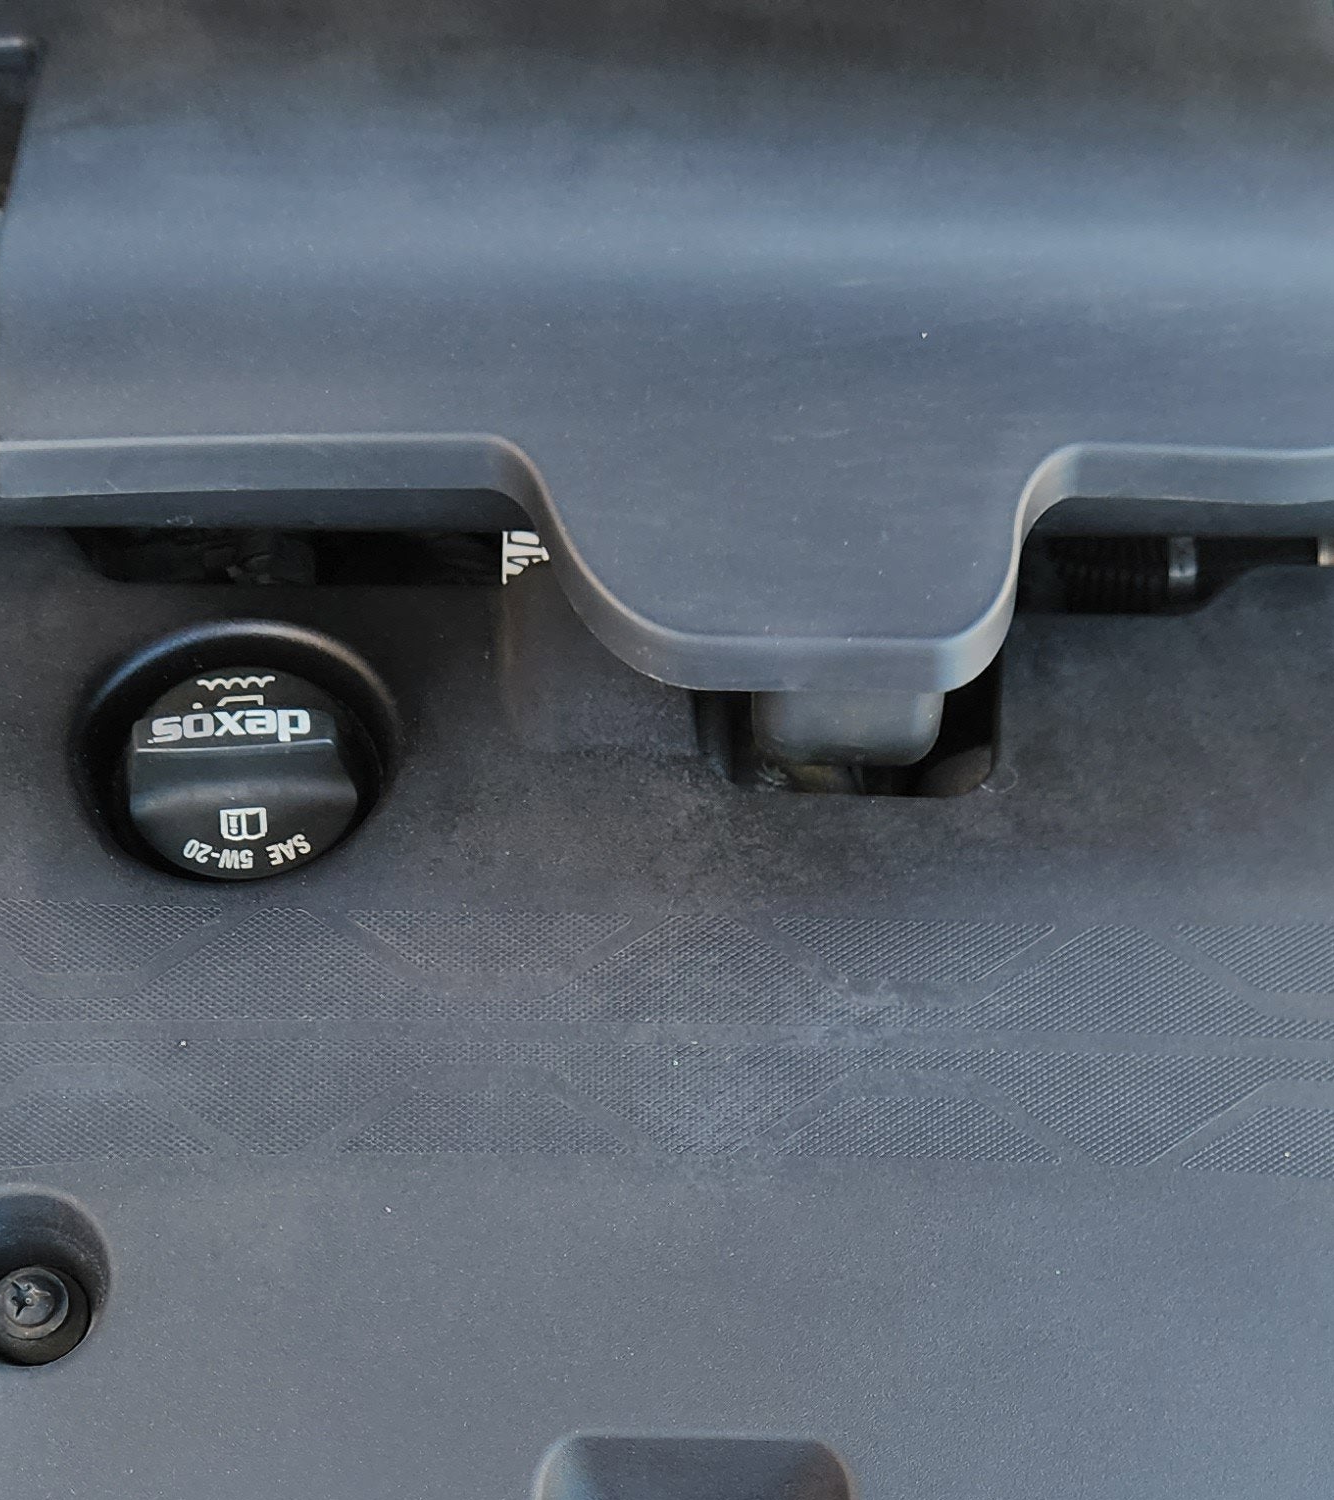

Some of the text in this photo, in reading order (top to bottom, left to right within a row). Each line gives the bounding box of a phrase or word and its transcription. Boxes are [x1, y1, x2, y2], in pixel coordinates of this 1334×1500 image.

[151, 709, 311, 743] dexos
[182, 833, 312, 870] SAE 5W-20
